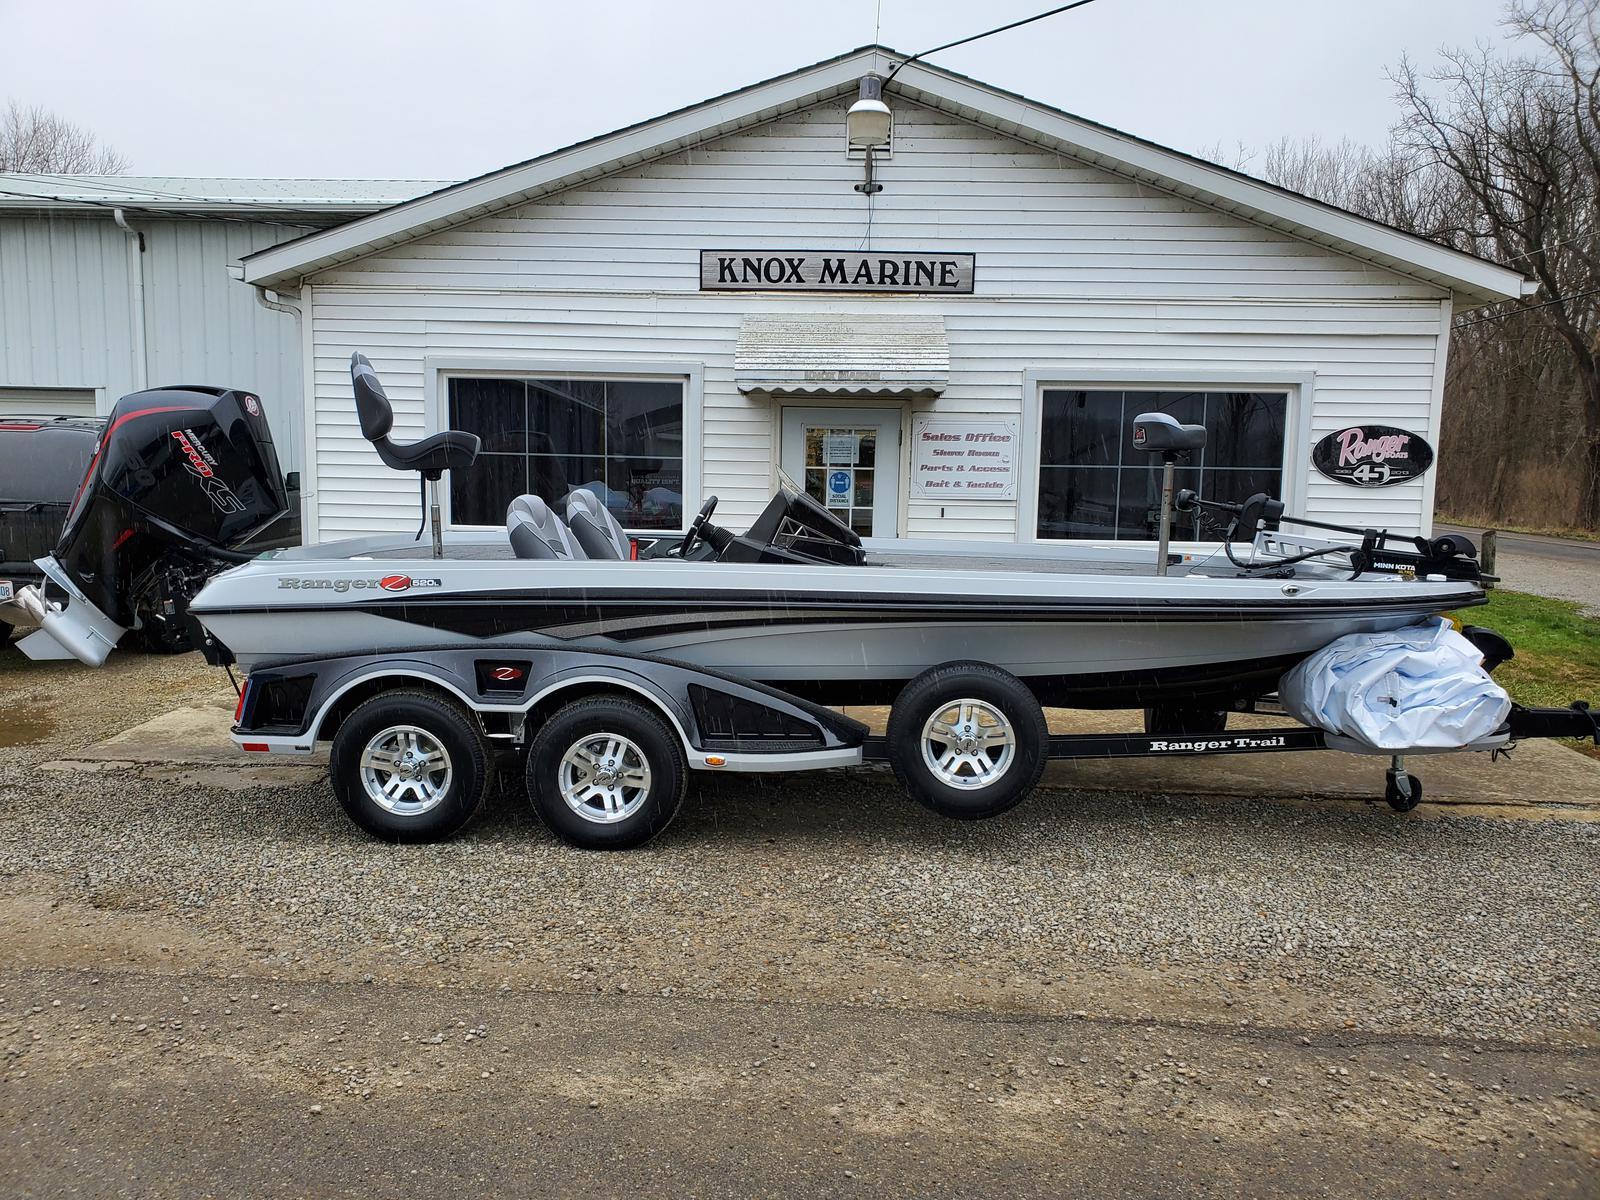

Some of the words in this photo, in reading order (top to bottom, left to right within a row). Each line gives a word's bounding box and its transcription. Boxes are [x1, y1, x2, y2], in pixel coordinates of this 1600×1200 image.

[717, 257, 806, 284] KNOX
[818, 258, 960, 288] MARINE
[921, 432, 962, 442] Sales
[964, 432, 1012, 443] Office
[171, 430, 214, 477] PRO
[184, 428, 219, 466] MERCURY
[931, 449, 965, 457] Show
[967, 449, 1000, 457] Room
[1336, 427, 1409, 467] Ranger
[1384, 451, 1409, 459] BOATS
[920, 464, 954, 472] Parts
[956, 464, 965, 472] &
[968, 465, 1011, 473] Access
[1353, 464, 1391, 482] 45
[924, 480, 950, 488] Bait
[965, 480, 1004, 488] Tackle
[1373, 562, 1395, 570] MINN
[1395, 563, 1416, 571] KOTA
[277, 577, 381, 593] Ranger
[1149, 740, 1231, 752] Ranger
[1234, 737, 1286, 748] Trail
